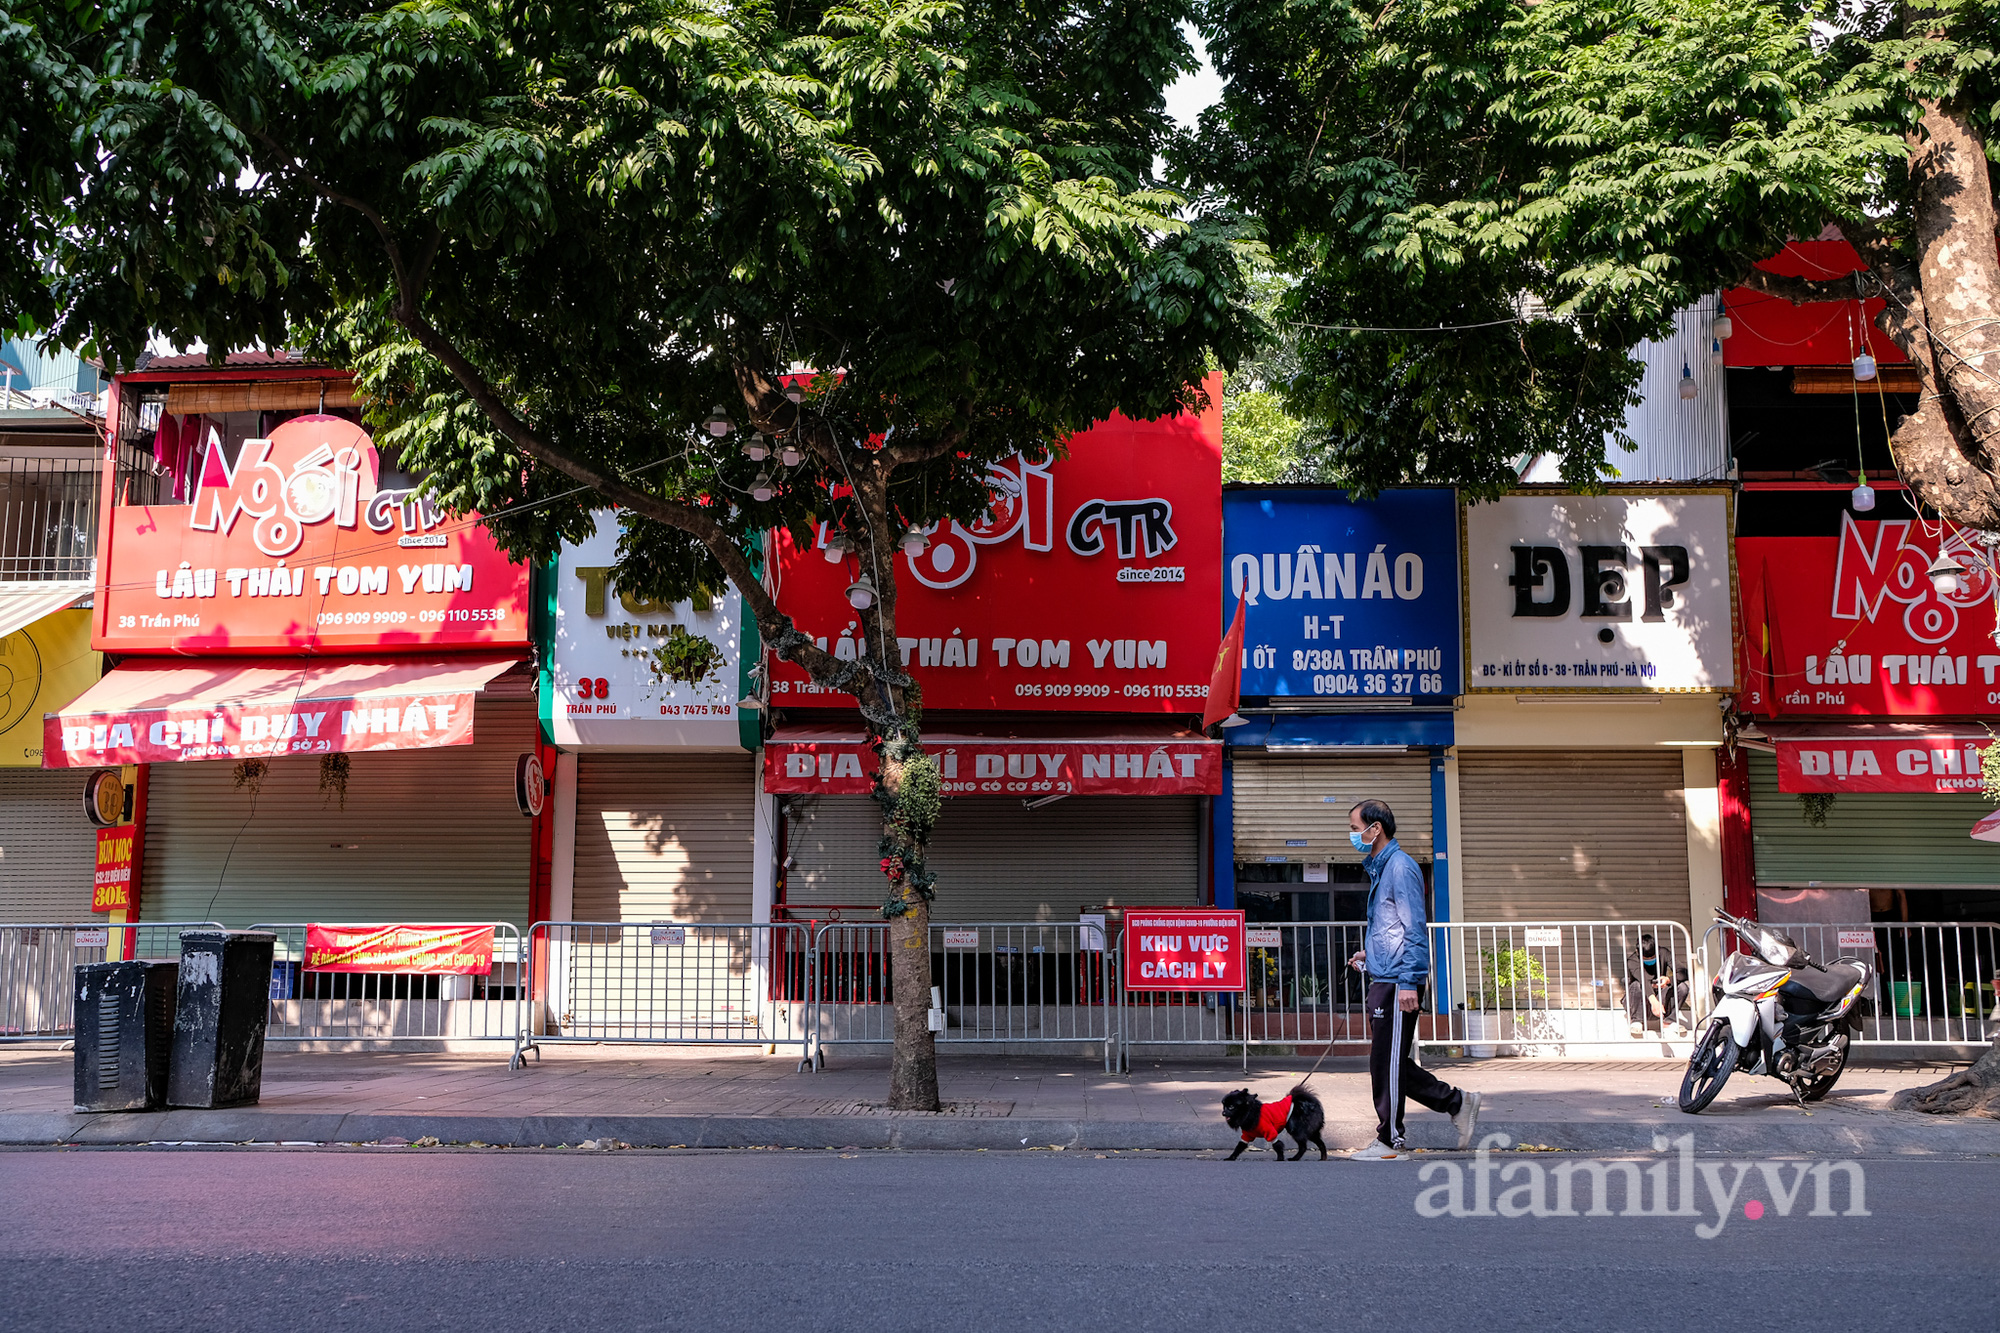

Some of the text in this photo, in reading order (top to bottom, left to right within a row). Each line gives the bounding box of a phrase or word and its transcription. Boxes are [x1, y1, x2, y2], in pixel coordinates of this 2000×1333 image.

[1066, 498, 1178, 559] CTR
[400, 535, 444, 545] since 2014
[225, 559, 305, 597] THÁI
[314, 565, 389, 596] TOM
[397, 563, 473, 594] YUM
[1119, 569, 1183, 580] since 2014
[1230, 544, 1424, 606] QUẦN ÁO
[1508, 545, 1690, 643] ĐẸP
[118, 615, 136, 628] 38
[174, 613, 200, 627] Phú
[317, 608, 505, 625] 096 909 9909 096 110 5538
[605, 622, 686, 641] VIỆT NAM
[1303, 615, 1345, 640] H-T
[897, 627, 978, 668] THÁI
[992, 637, 1071, 669] TOM
[1086, 638, 1168, 669] YUM
[1253, 644, 1277, 669] ỐT
[1292, 649, 1345, 671] 8/38A
[1350, 645, 1399, 671] TRẦN
[1404, 646, 1442, 671] PHÚ
[1542, 664, 1548, 676] 6
[1555, 664, 1567, 676] 38
[1600, 661, 1618, 677] PHÚ
[1625, 661, 1638, 677] HÀ
[1805, 639, 1872, 685] LẨU
[1882, 646, 1968, 686] THÁI
[577, 677, 609, 699] 38
[772, 680, 790, 694] 38
[1015, 684, 1210, 698] 096 909 9909 096 110 5538
[1313, 674, 1443, 694] 0904 36 37 66
[596, 701, 617, 714] PHÚ
[1784, 689, 1810, 705] rần
[1816, 691, 1845, 705] Phú
[660, 705, 681, 715] 043
[684, 705, 708, 715] 7475
[61, 697, 456, 754] ĐỊA CHỈ DUY NHẤT
[317, 738, 332, 752] 2)
[785, 753, 864, 783] ĐỊA
[975, 753, 1067, 779] DUY
[1082, 745, 1202, 778] NHẤT
[1799, 742, 1981, 781] ĐỊA CHỈ
[980, 780, 1002, 791] CÓ
[1006, 781, 1028, 792] CƠ
[1031, 779, 1053, 792] SỞ
[1056, 781, 1073, 793] 2)
[98, 833, 132, 868] BÚN MỌC
[94, 885, 127, 907] 30k
[1140, 934, 1229, 955] KHU VỰC
[454, 953, 486, 967] COVID-19
[1140, 958, 1227, 979] CÁCH LY
